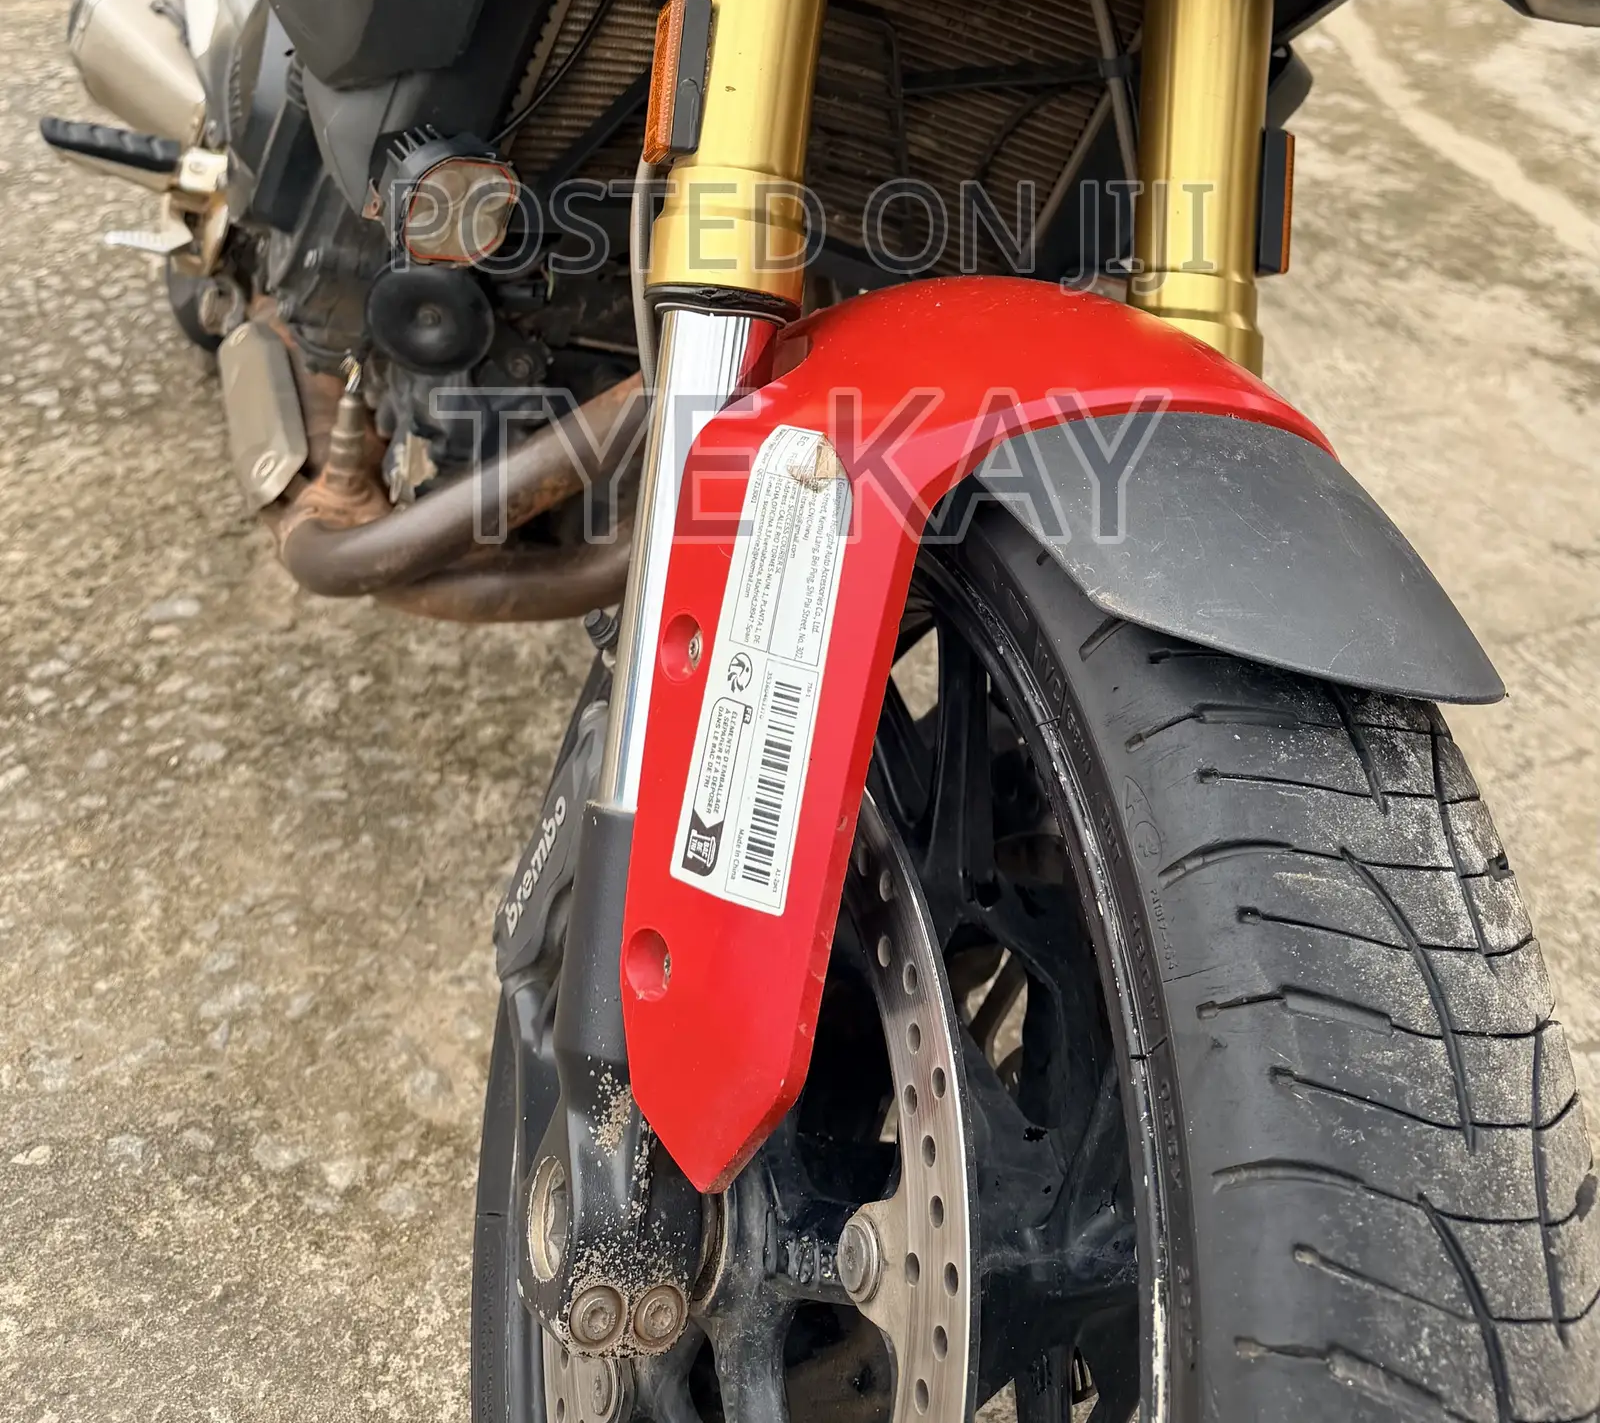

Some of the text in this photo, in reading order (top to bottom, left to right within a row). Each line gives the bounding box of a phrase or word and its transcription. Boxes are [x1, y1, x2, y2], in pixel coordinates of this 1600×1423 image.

[796, 435, 809, 447] EC
[775, 508, 785, 530] CALLE
[782, 503, 794, 535] SUCCESS
[767, 543, 778, 573] TORMES
[776, 535, 787, 565] COURIER
[810, 554, 819, 567] Bei
[823, 549, 833, 567] Auto
[816, 566, 829, 607] Accessories
[756, 599, 767, 627] PLANTA
[798, 608, 809, 633] Street,
[742, 622, 752, 643] Spain
[793, 645, 803, 661] 302,
[505, 796, 566, 938] brembo
